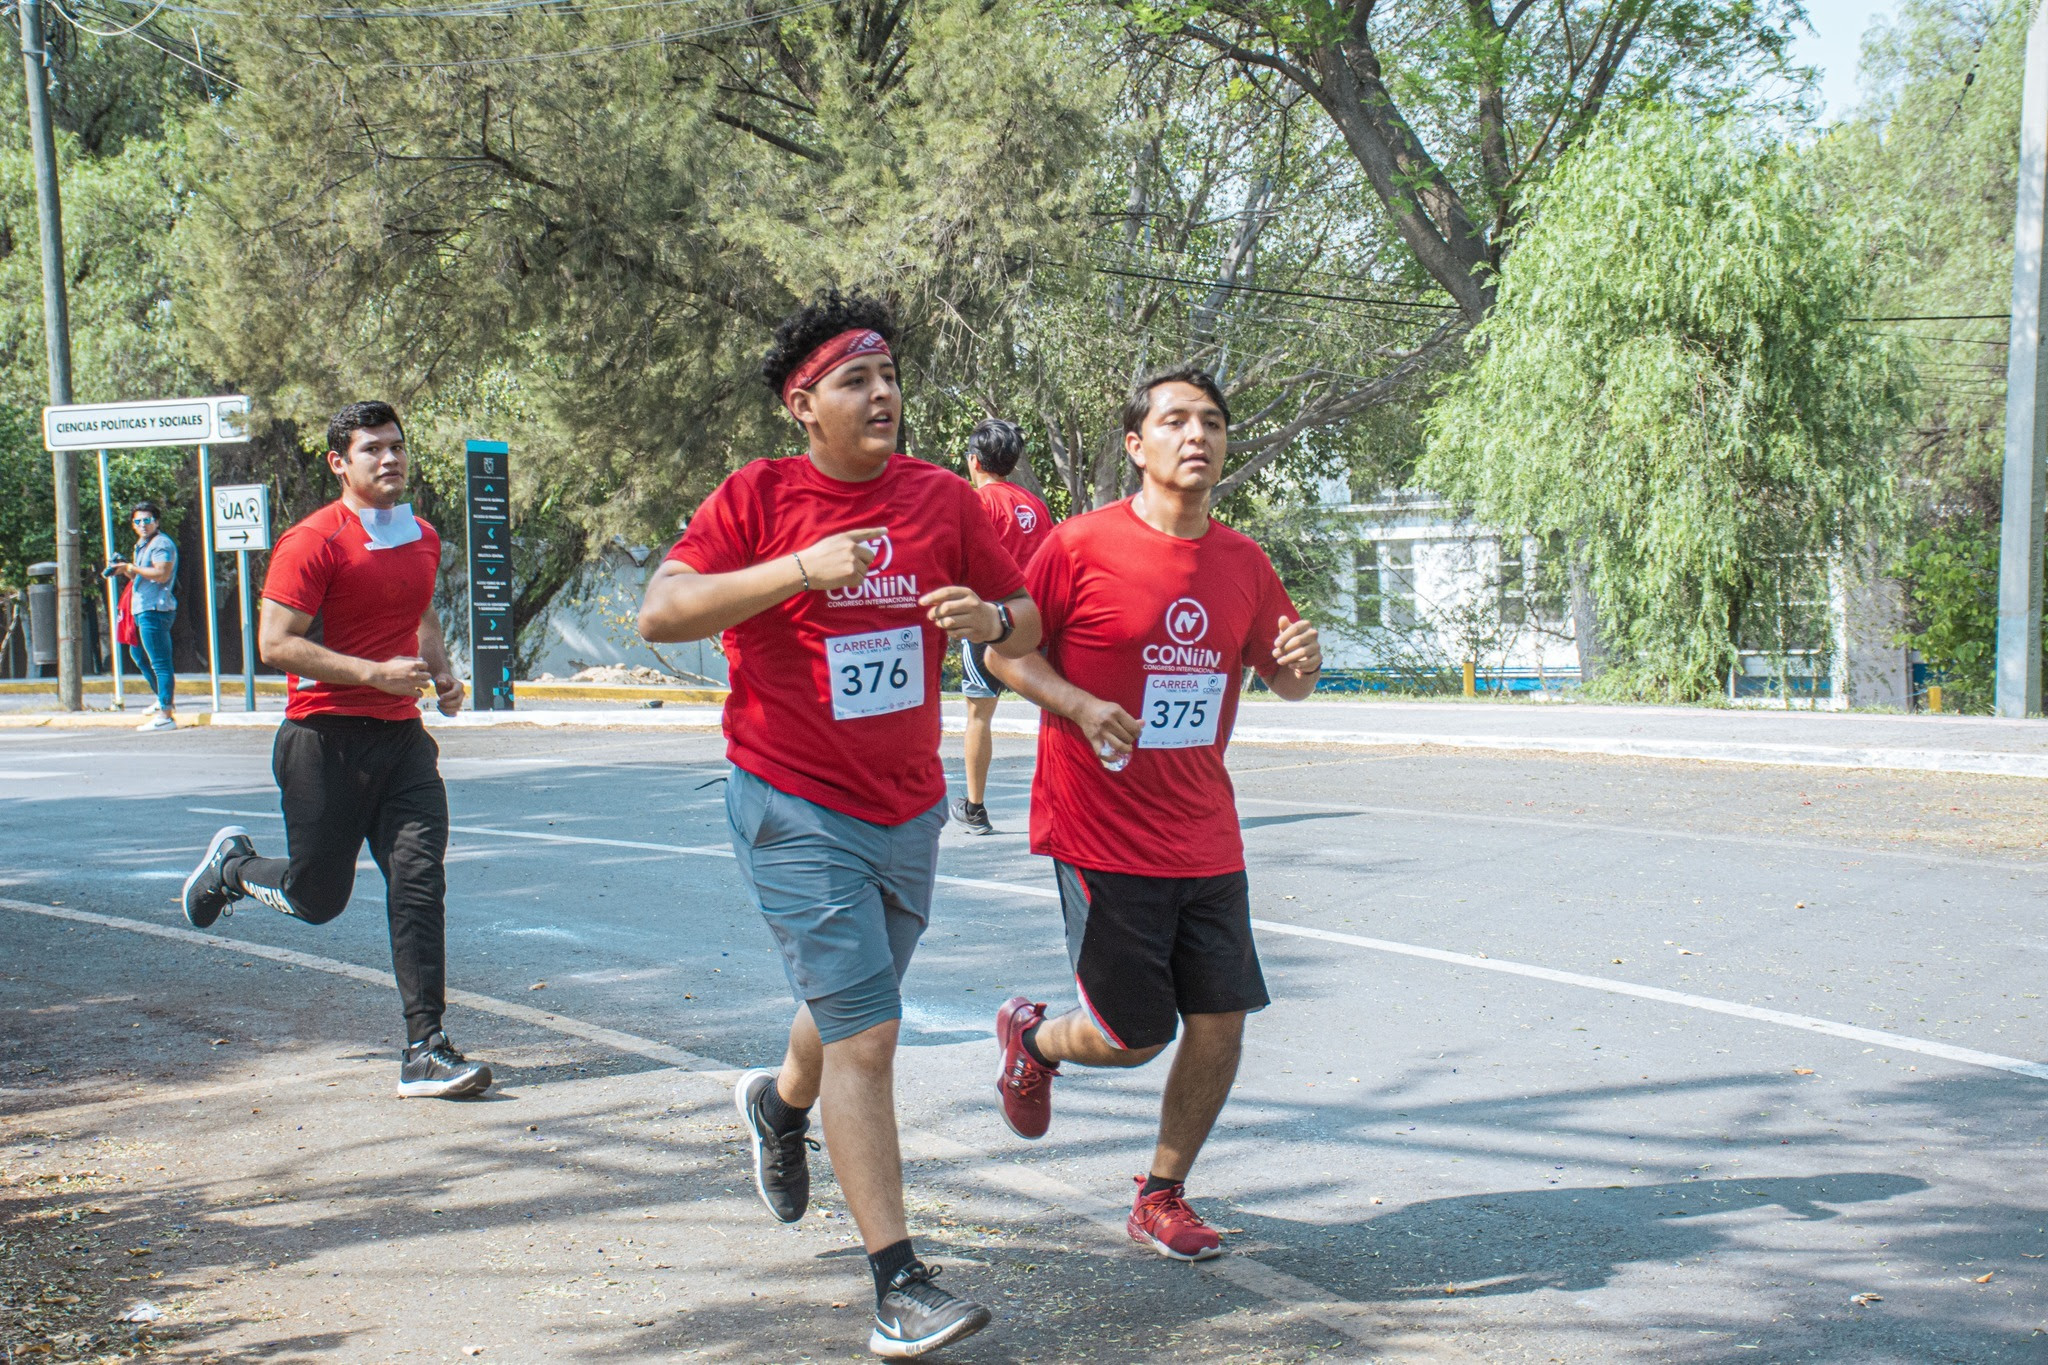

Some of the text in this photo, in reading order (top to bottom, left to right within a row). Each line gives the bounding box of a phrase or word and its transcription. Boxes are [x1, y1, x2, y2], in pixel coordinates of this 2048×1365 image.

[56, 415, 203, 433] CIENCIAS POLÍTICAS Y SOCIALES
[827, 596, 917, 608] CONGRESO INTERNACIONAL
[833, 637, 891, 654] CARRERA
[1143, 644, 1221, 668] CONiiN
[1143, 664, 1175, 672] CONGRESO
[841, 658, 908, 696] 376
[1152, 679, 1199, 689] CARRERA
[1150, 700, 1207, 728] 375
